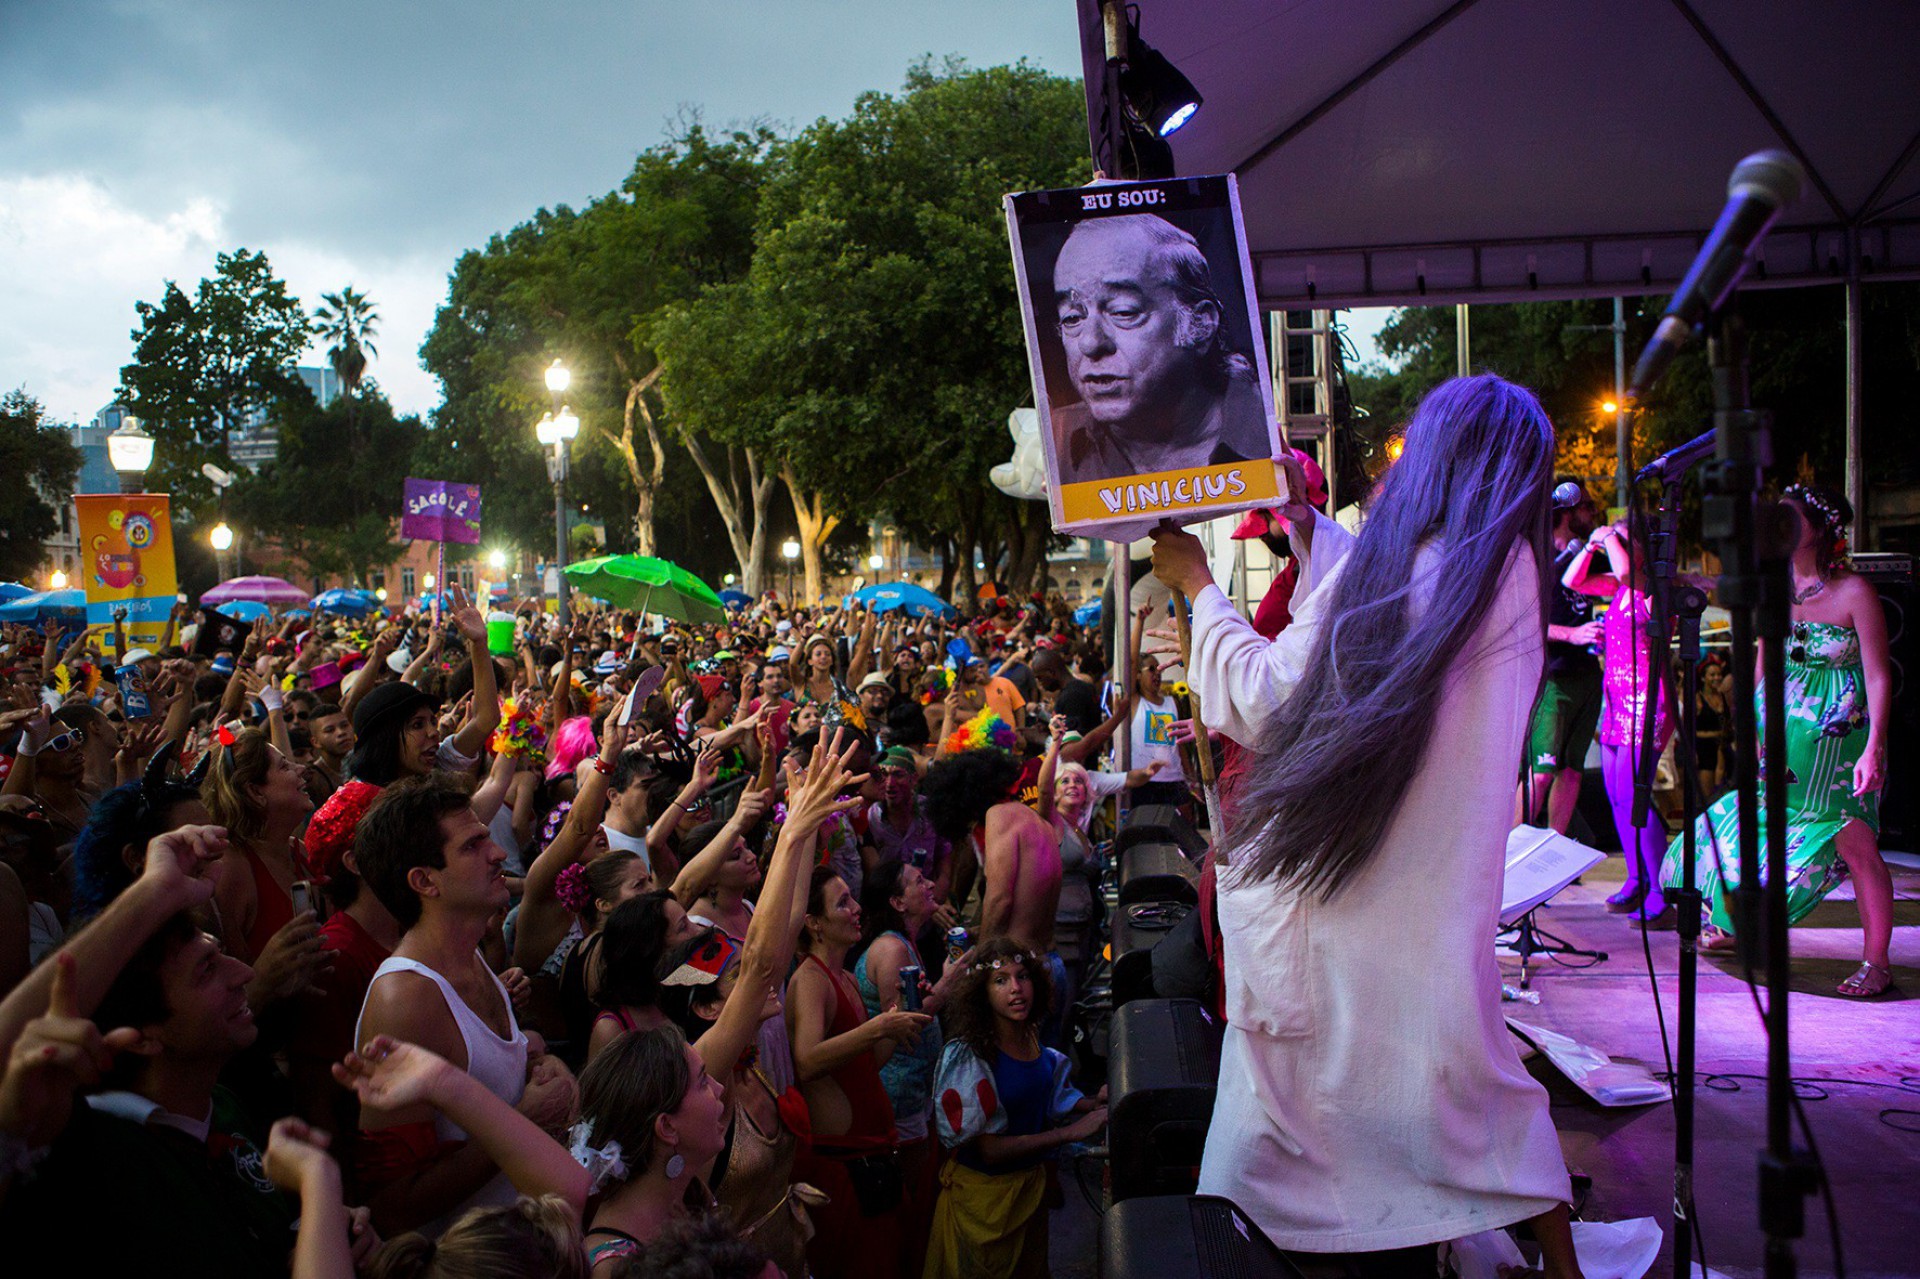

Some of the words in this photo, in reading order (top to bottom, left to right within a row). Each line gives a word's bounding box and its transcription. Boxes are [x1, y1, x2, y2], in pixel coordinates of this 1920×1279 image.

[1081, 193, 1113, 210] EU
[1117, 188, 1166, 208] SOU:
[1098, 469, 1247, 514] VINICIUS
